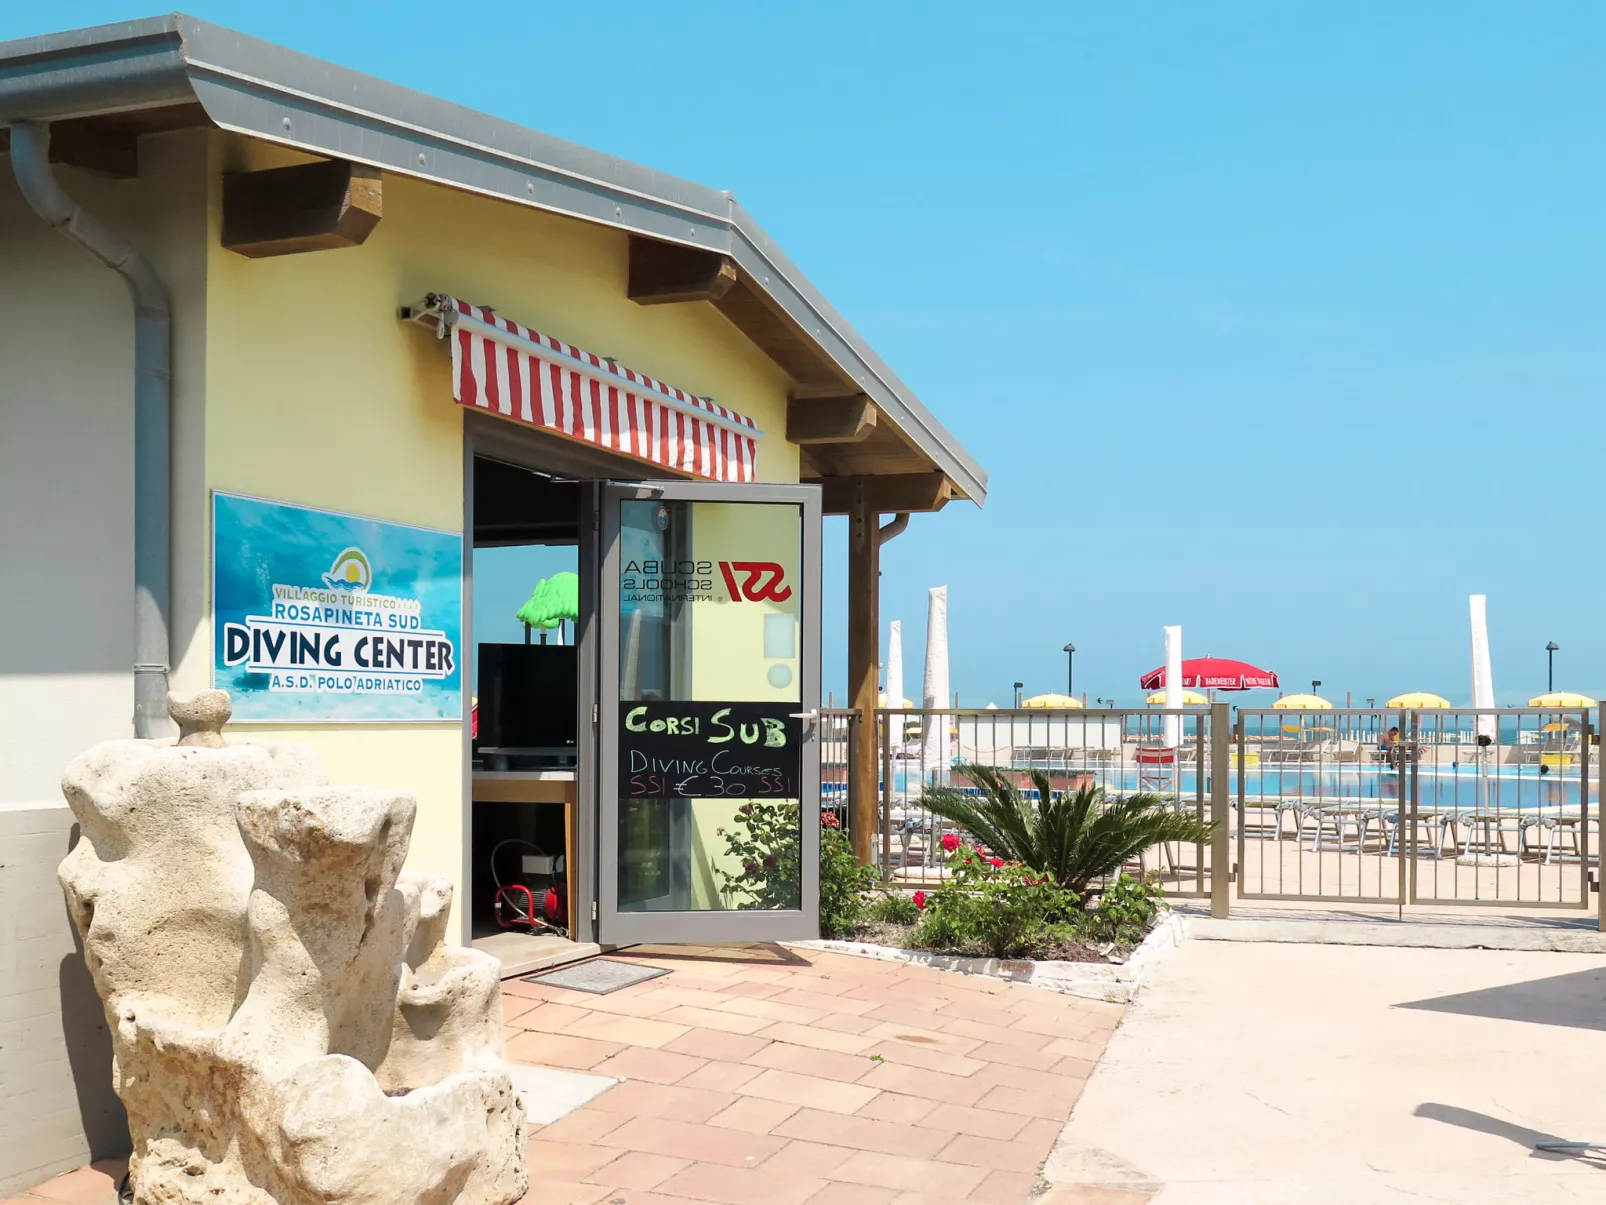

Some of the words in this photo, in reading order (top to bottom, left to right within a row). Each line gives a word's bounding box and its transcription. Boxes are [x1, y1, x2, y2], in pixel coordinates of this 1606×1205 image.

[275, 587, 337, 604] VILLAGGIO
[341, 595, 396, 609] TURISTICO
[275, 604, 382, 627] ROSAPINETA
[388, 613, 419, 630] SUD
[227, 627, 342, 667] DIVING
[353, 635, 453, 671] CENTER
[272, 675, 313, 689] A.S.D.
[318, 677, 352, 690] POLO
[356, 678, 421, 691] ADRIATICO
[707, 708, 787, 748] SUB
[630, 750, 708, 775] DIVING
[711, 750, 783, 777] COURSES
[630, 775, 666, 795] SSI
[758, 776, 791, 794] SSI
